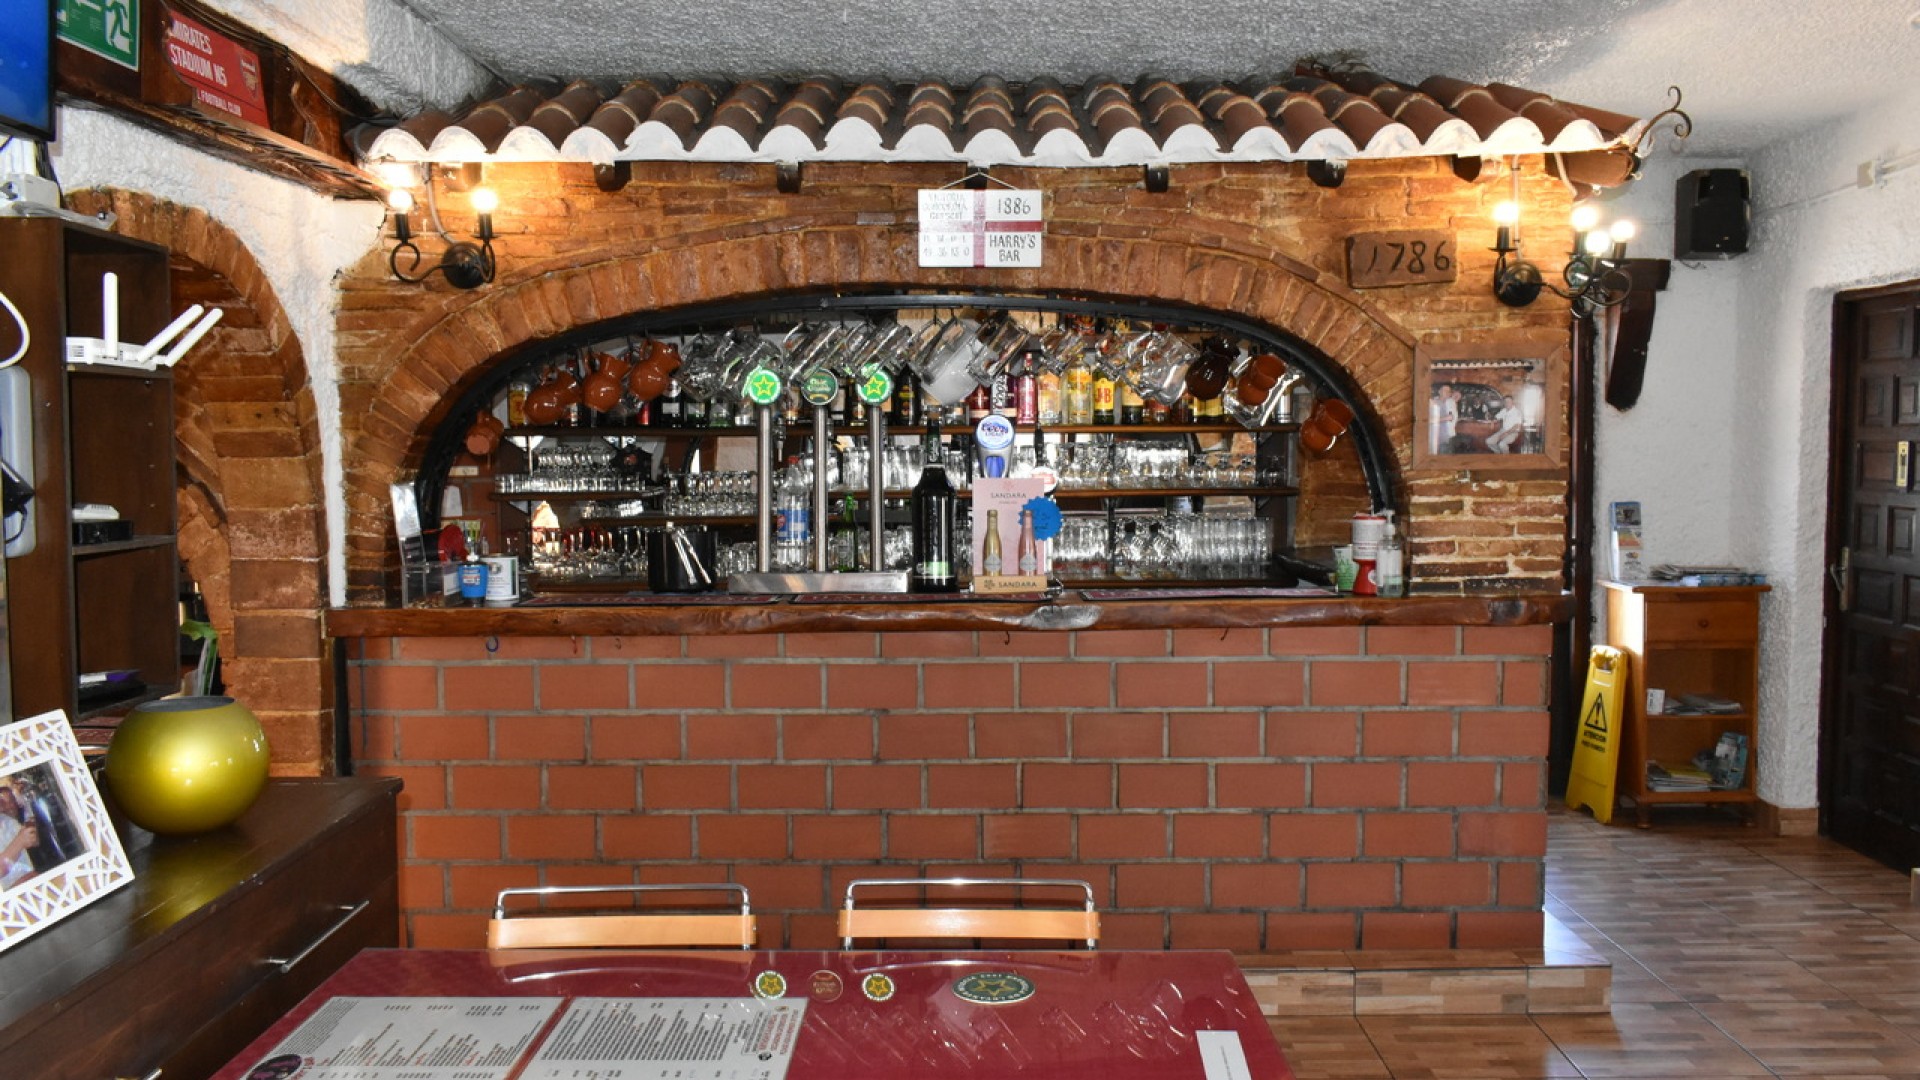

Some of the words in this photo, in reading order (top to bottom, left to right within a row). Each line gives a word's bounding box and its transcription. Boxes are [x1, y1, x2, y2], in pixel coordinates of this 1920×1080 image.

[168, 20, 212, 55] MIRATES
[170, 43, 214, 80] STADIUM
[213, 63, 227, 87] N5
[201, 90, 229, 112] FOOTBALL
[227, 101, 242, 117] CLUB
[998, 197, 1032, 215] 1886
[989, 234, 1036, 250] HARRY'S
[998, 248, 1021, 263] BAR
[1365, 239, 1450, 275] 1786
[998, 581, 1037, 589] SANDARA
